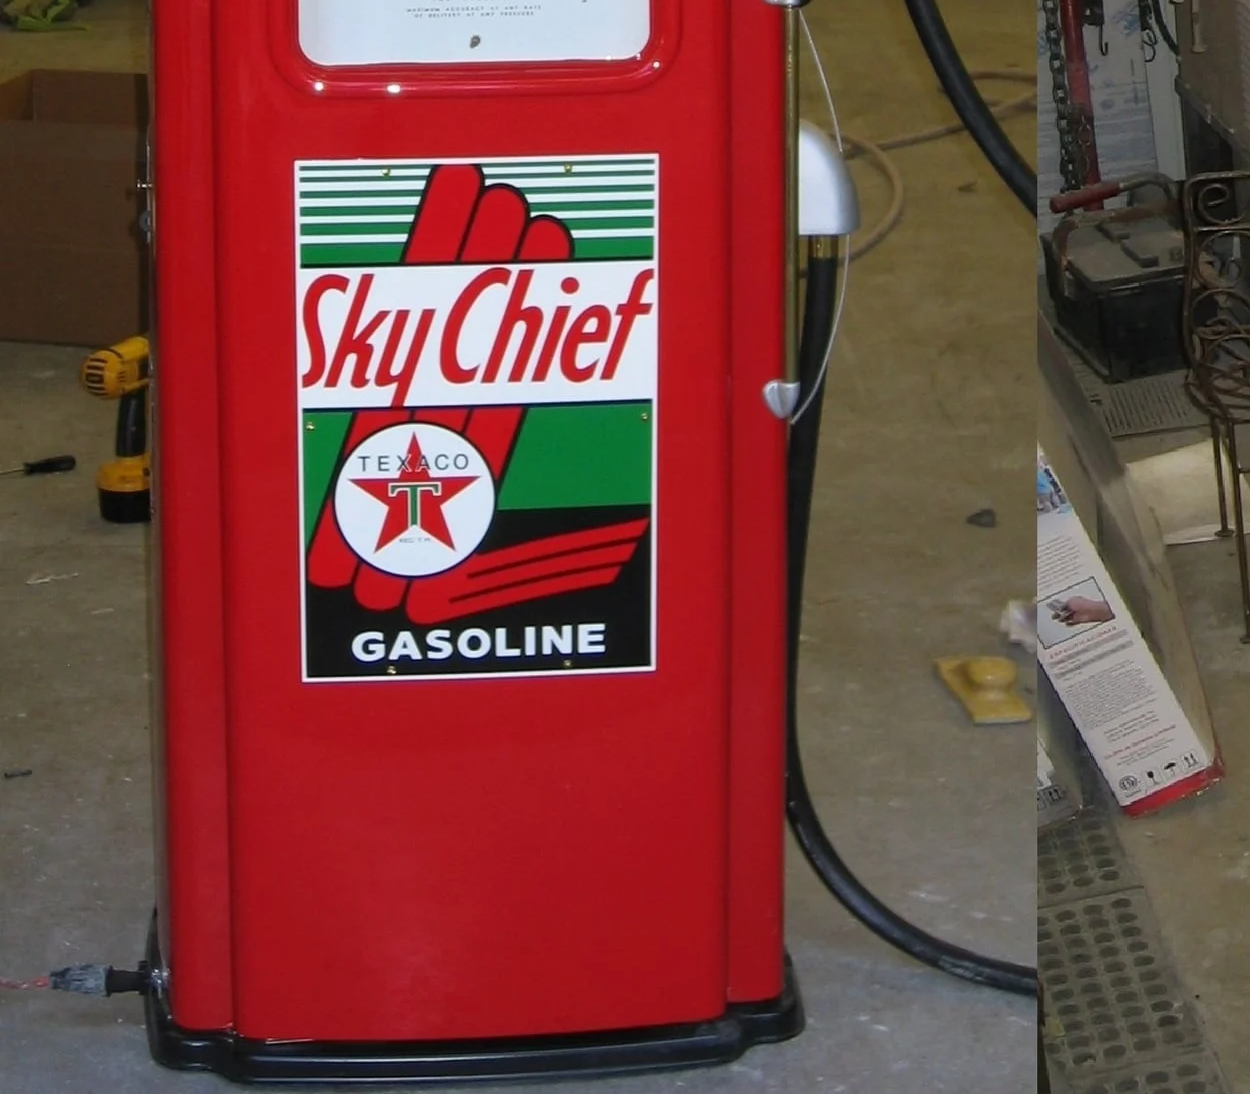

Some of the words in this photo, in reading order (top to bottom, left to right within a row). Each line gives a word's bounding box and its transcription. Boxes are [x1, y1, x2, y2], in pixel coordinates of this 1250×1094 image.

[302, 273, 436, 407] Sky
[439, 266, 654, 384] Chief
[357, 453, 470, 473] TEXACO
[351, 623, 607, 662] GASOLINE
